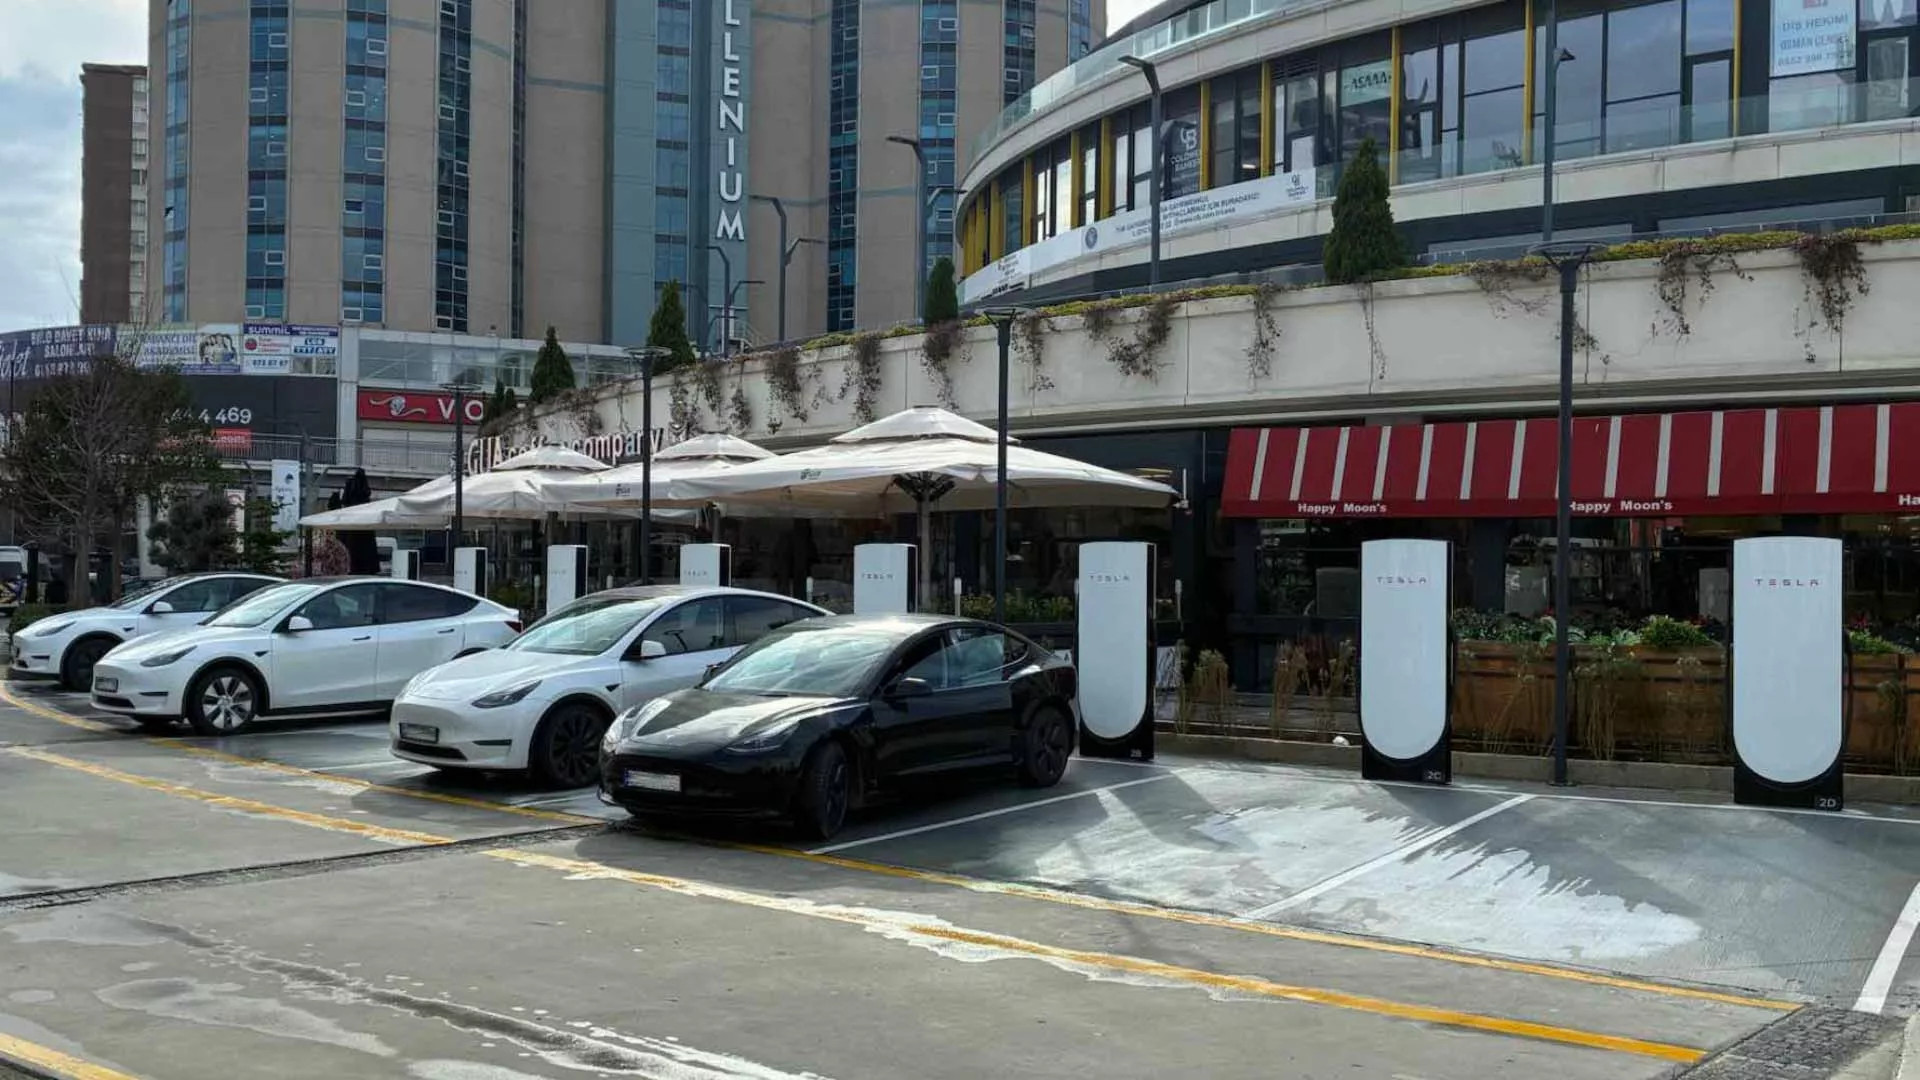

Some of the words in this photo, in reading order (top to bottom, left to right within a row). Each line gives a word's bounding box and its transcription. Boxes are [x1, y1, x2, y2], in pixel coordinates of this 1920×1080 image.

[215, 406, 251, 424] 469
[1298, 503, 1336, 515] Happy
[1343, 503, 1387, 513] Moon's
[1620, 500, 1673, 511] Moon's
[1376, 576, 1426, 584] TESLA
[1754, 578, 1819, 587] TESLA
[1819, 798, 1837, 808] 2D
